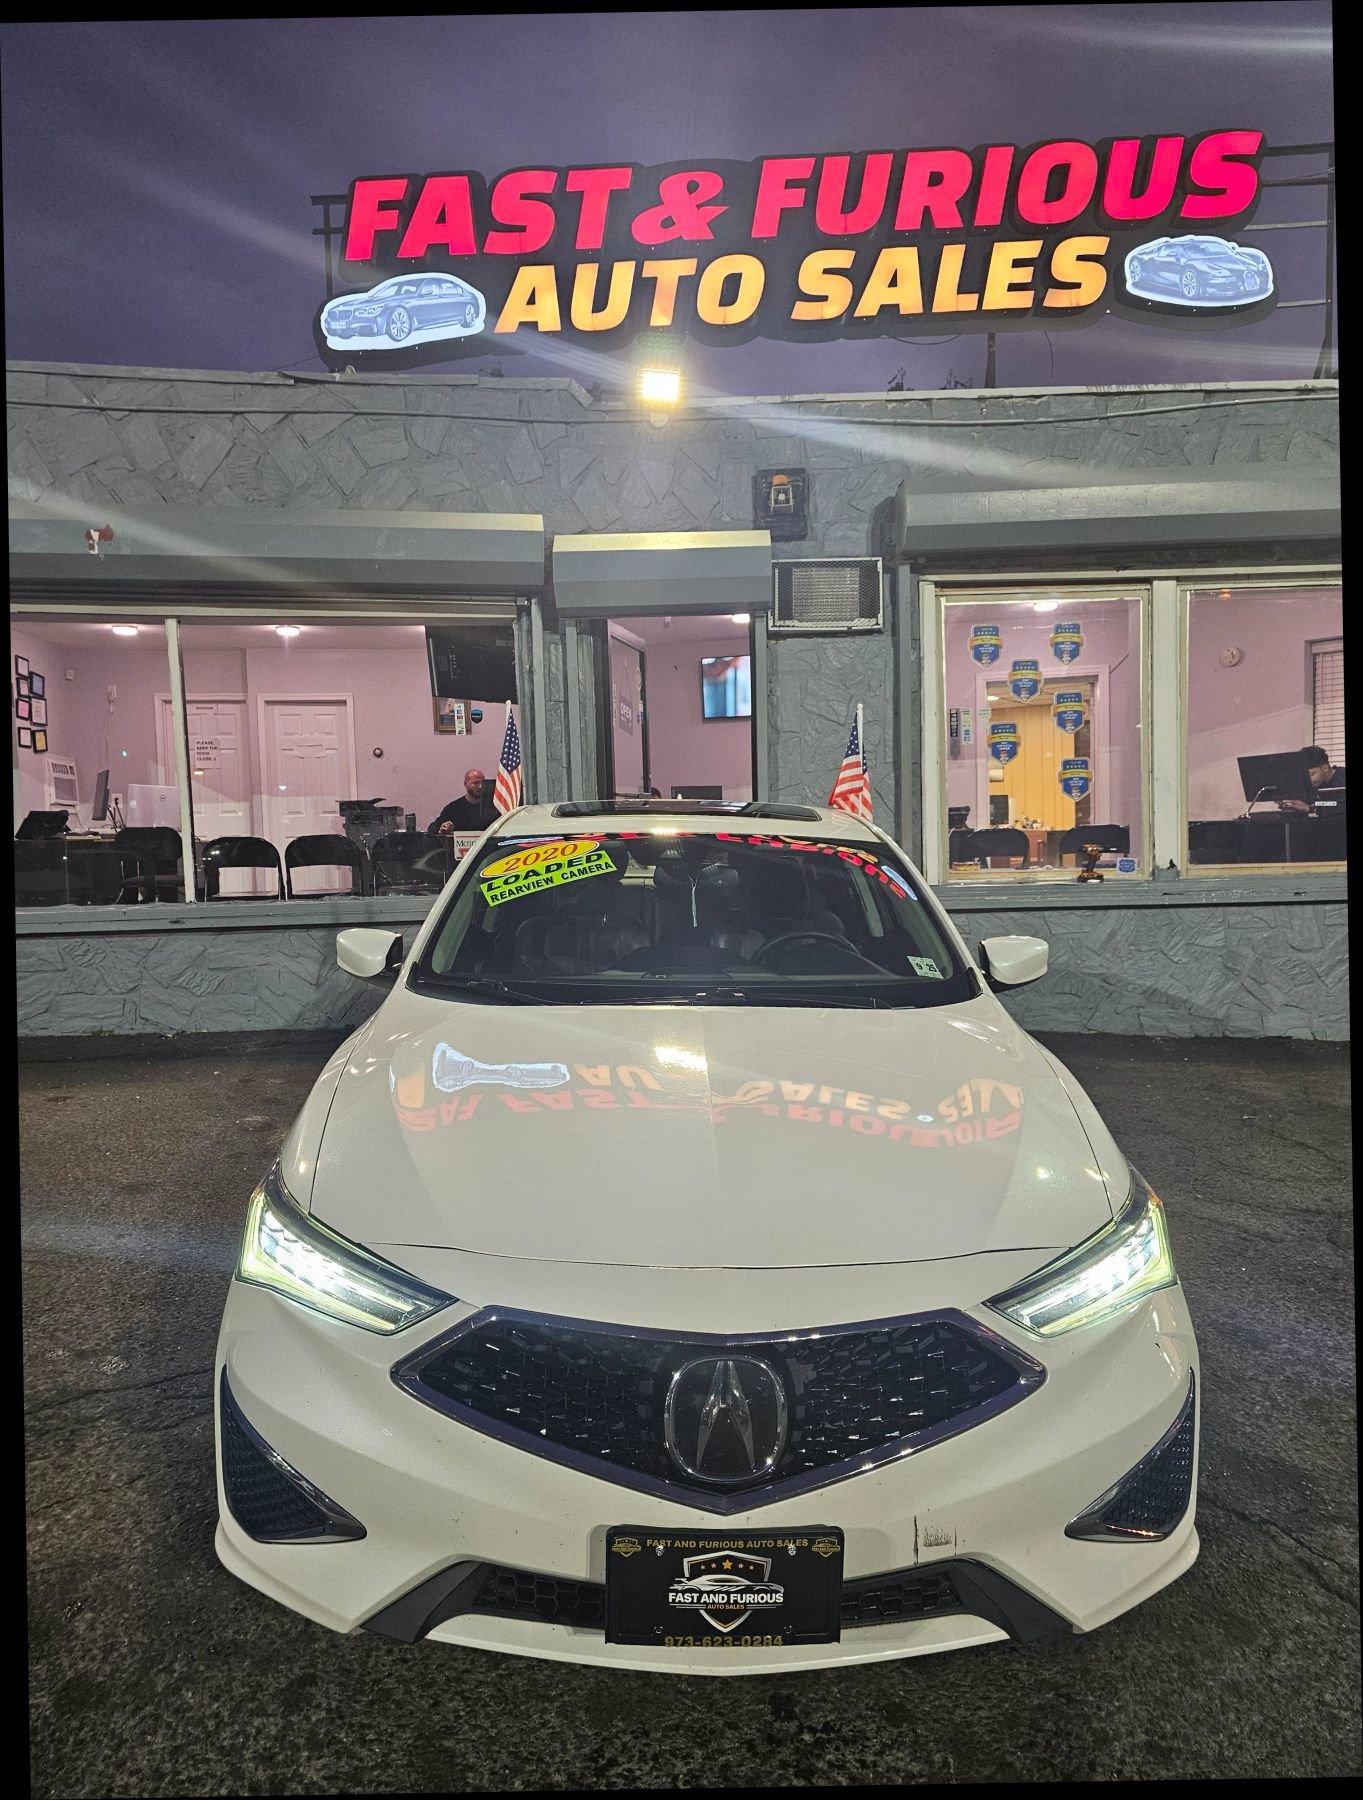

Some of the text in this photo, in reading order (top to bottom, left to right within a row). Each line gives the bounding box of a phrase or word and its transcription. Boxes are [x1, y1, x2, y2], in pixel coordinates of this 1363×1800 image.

[345, 131, 1262, 261] FAST & FURIOUS
[496, 236, 1108, 332] AUTO SALES
[486, 853, 603, 892] LOADED
[503, 843, 579, 873] 2020
[490, 862, 613, 903] REARVIEW CAMERA
[926, 963, 937, 972] 25
[647, 1538, 809, 1549] FAST AND FURIOUS AUTO SALES
[668, 1593, 784, 1603] FAST AND FURIOUS
[665, 1635, 784, 1648] 973-623-0284
